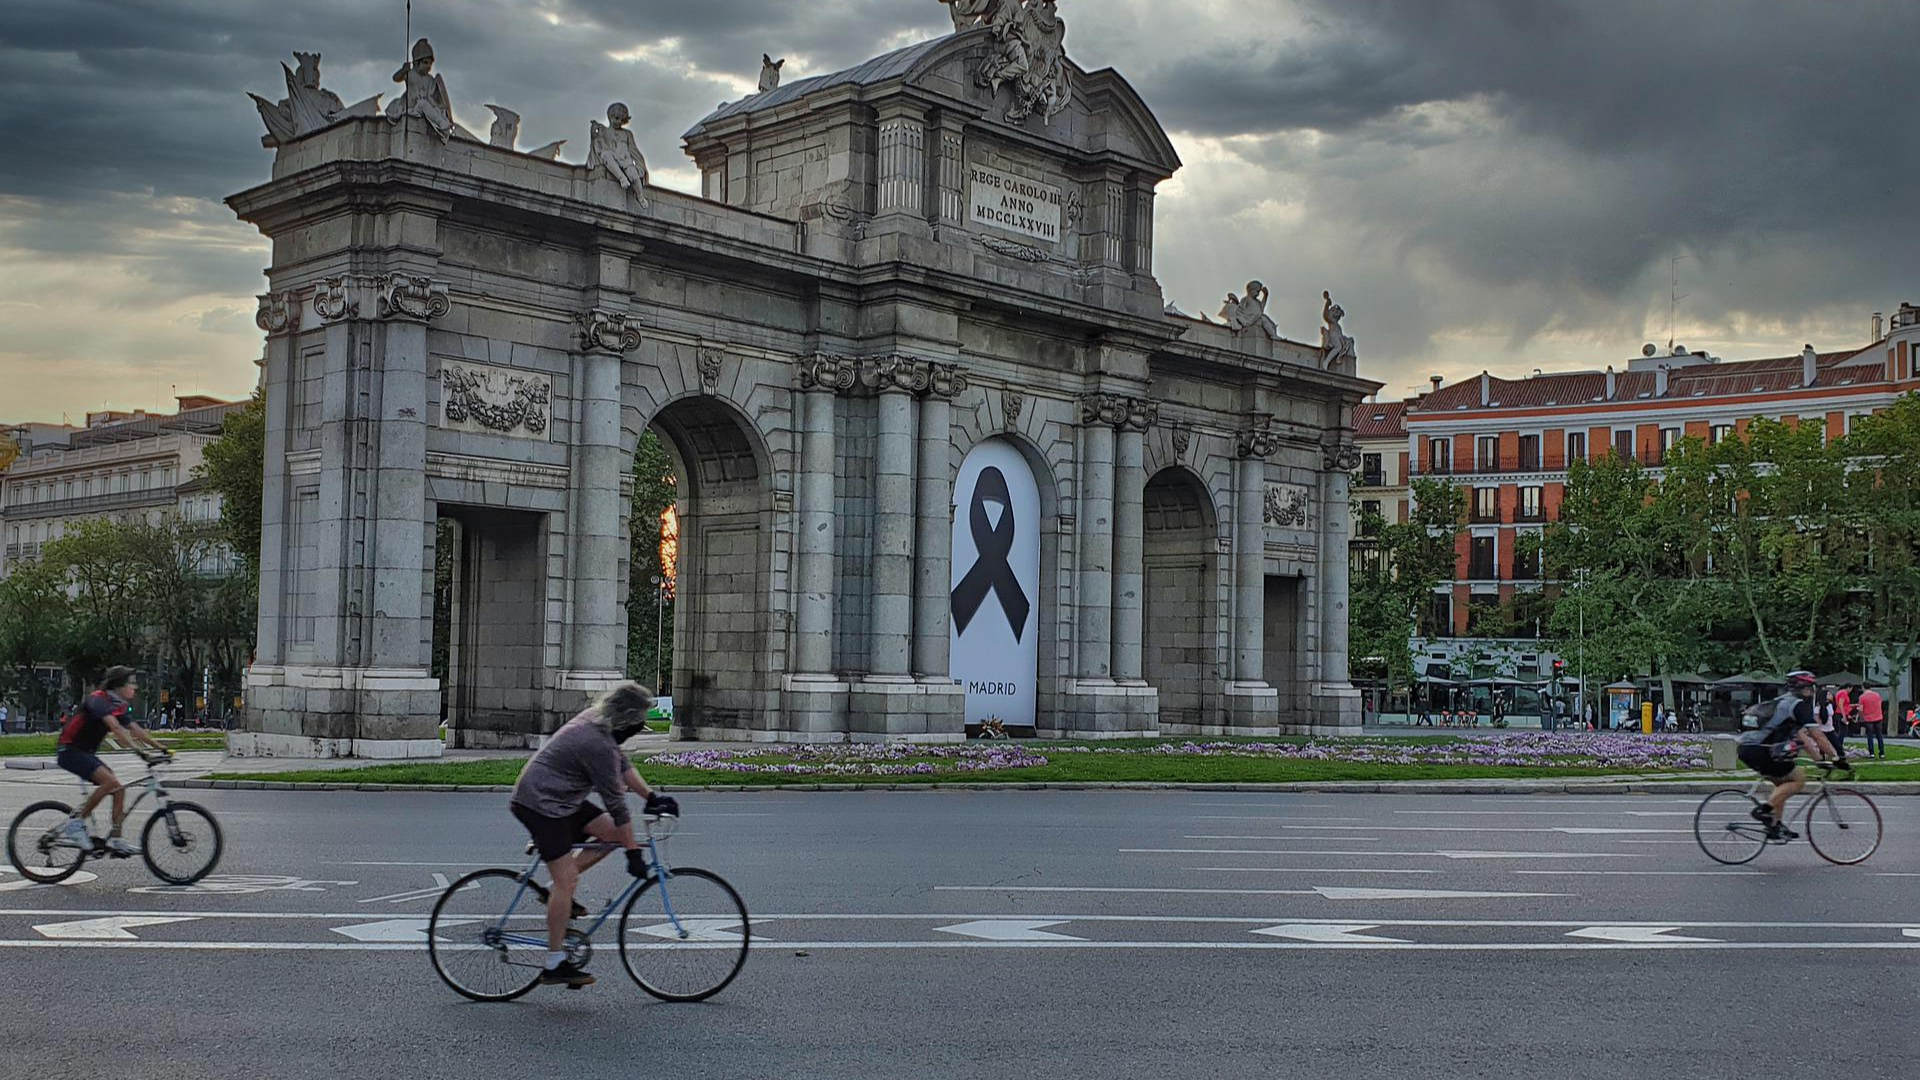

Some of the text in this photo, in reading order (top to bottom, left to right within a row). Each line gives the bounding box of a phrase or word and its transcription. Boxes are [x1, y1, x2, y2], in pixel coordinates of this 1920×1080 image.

[970, 169, 1061, 205] REGE CAROLO III
[1000, 195, 1034, 213] ANNO
[976, 205, 1055, 237] MDCCLXXVIII
[969, 681, 1016, 696] MADRID
